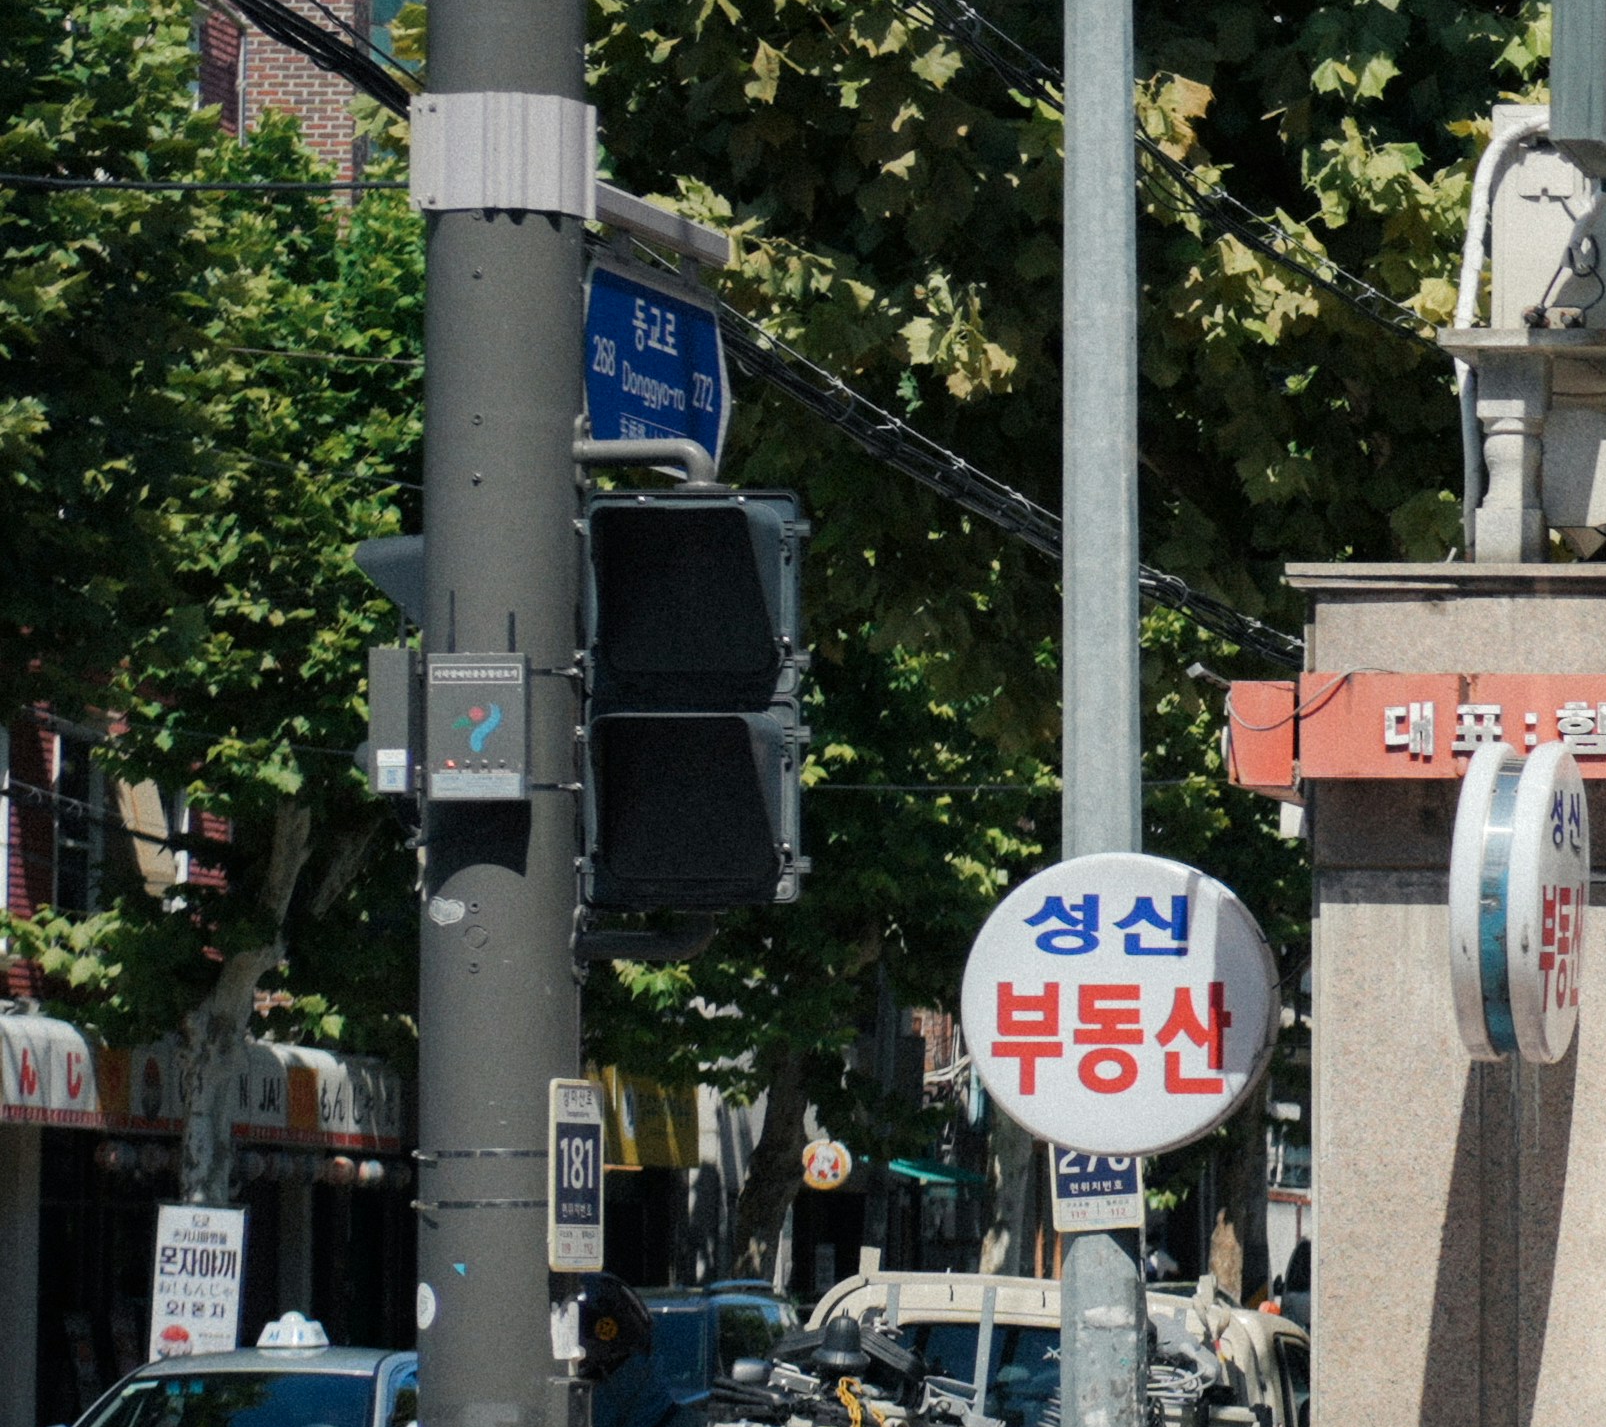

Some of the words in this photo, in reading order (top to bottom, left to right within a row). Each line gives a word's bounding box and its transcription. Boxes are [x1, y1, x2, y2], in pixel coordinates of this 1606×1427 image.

[632, 298, 678, 356] 동교로
[592, 336, 616, 377] 268
[622, 360, 686, 410] Donggyo-ro
[692, 372, 714, 413] 272
[1549, 788, 1583, 851] 성신
[1025, 894, 1191, 957] 성신
[1538, 882, 1586, 1012] 부동산
[991, 981, 1232, 1096] 부동산
[559, 1138, 593, 1189] 181
[1069, 1180, 1123, 1194] 현위치번호
[158, 1245, 237, 1280] 몬자야끼
